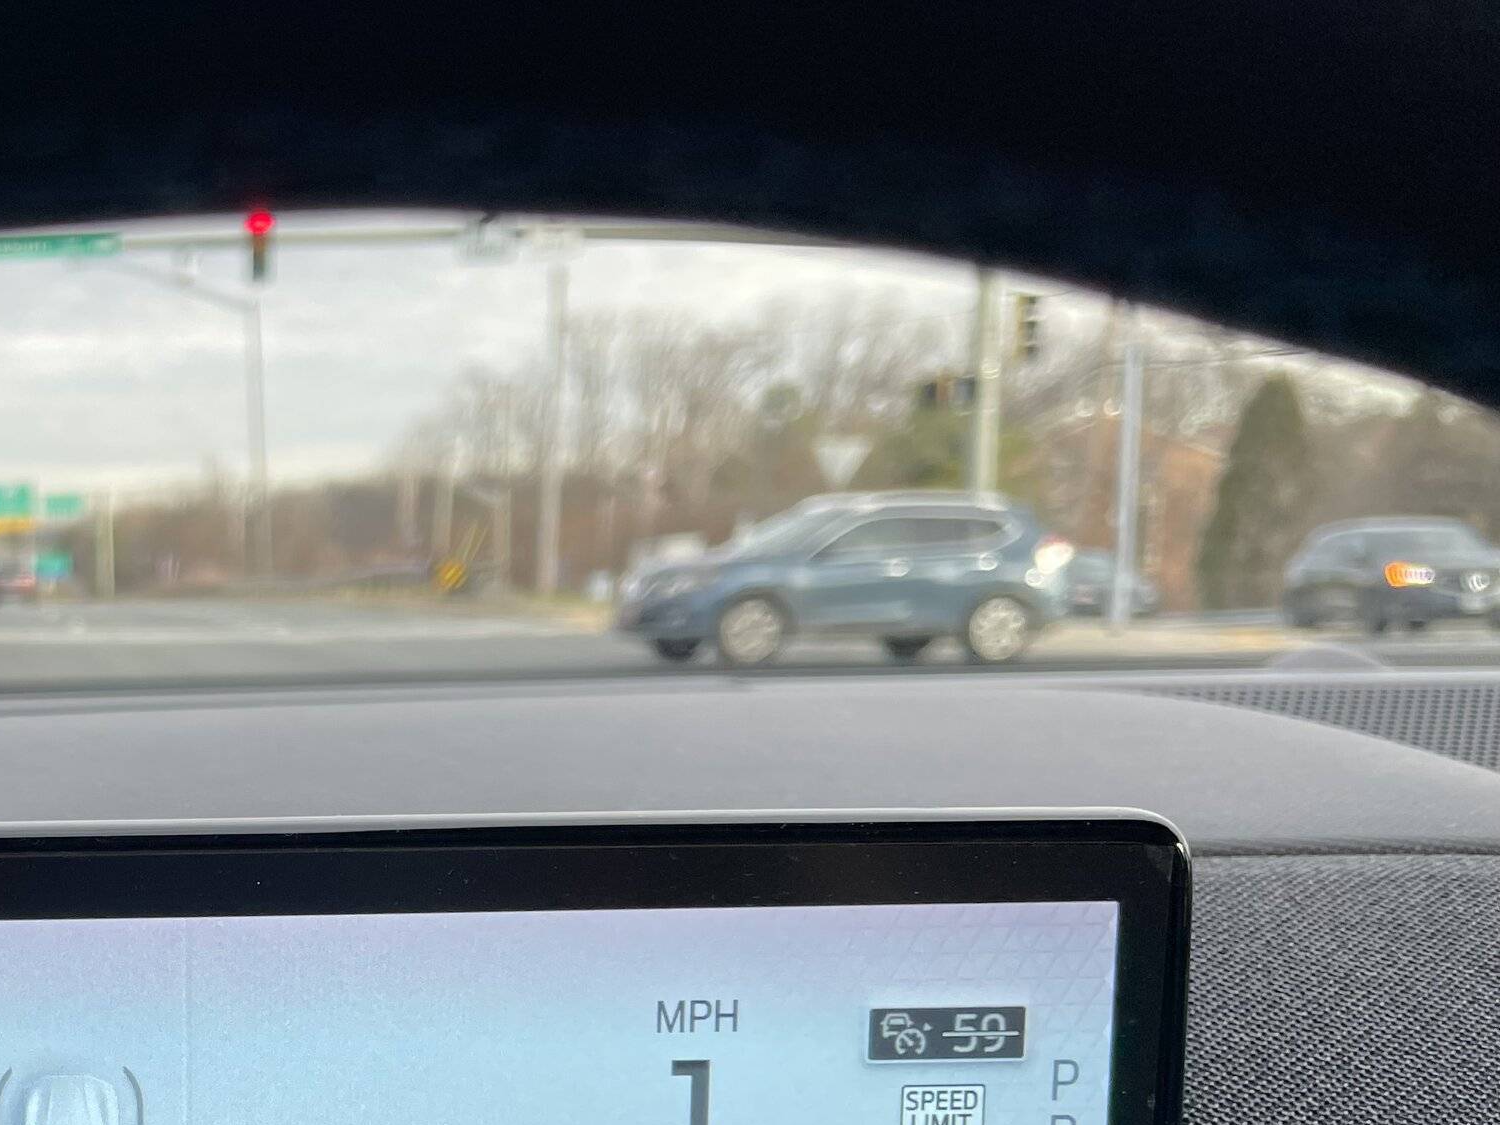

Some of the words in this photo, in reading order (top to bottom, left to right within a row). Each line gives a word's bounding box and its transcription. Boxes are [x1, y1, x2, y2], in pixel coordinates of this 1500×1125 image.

[656, 999, 739, 1033] MPH
[1051, 1059, 1080, 1101] P
[905, 1090, 979, 1111] SPEED
